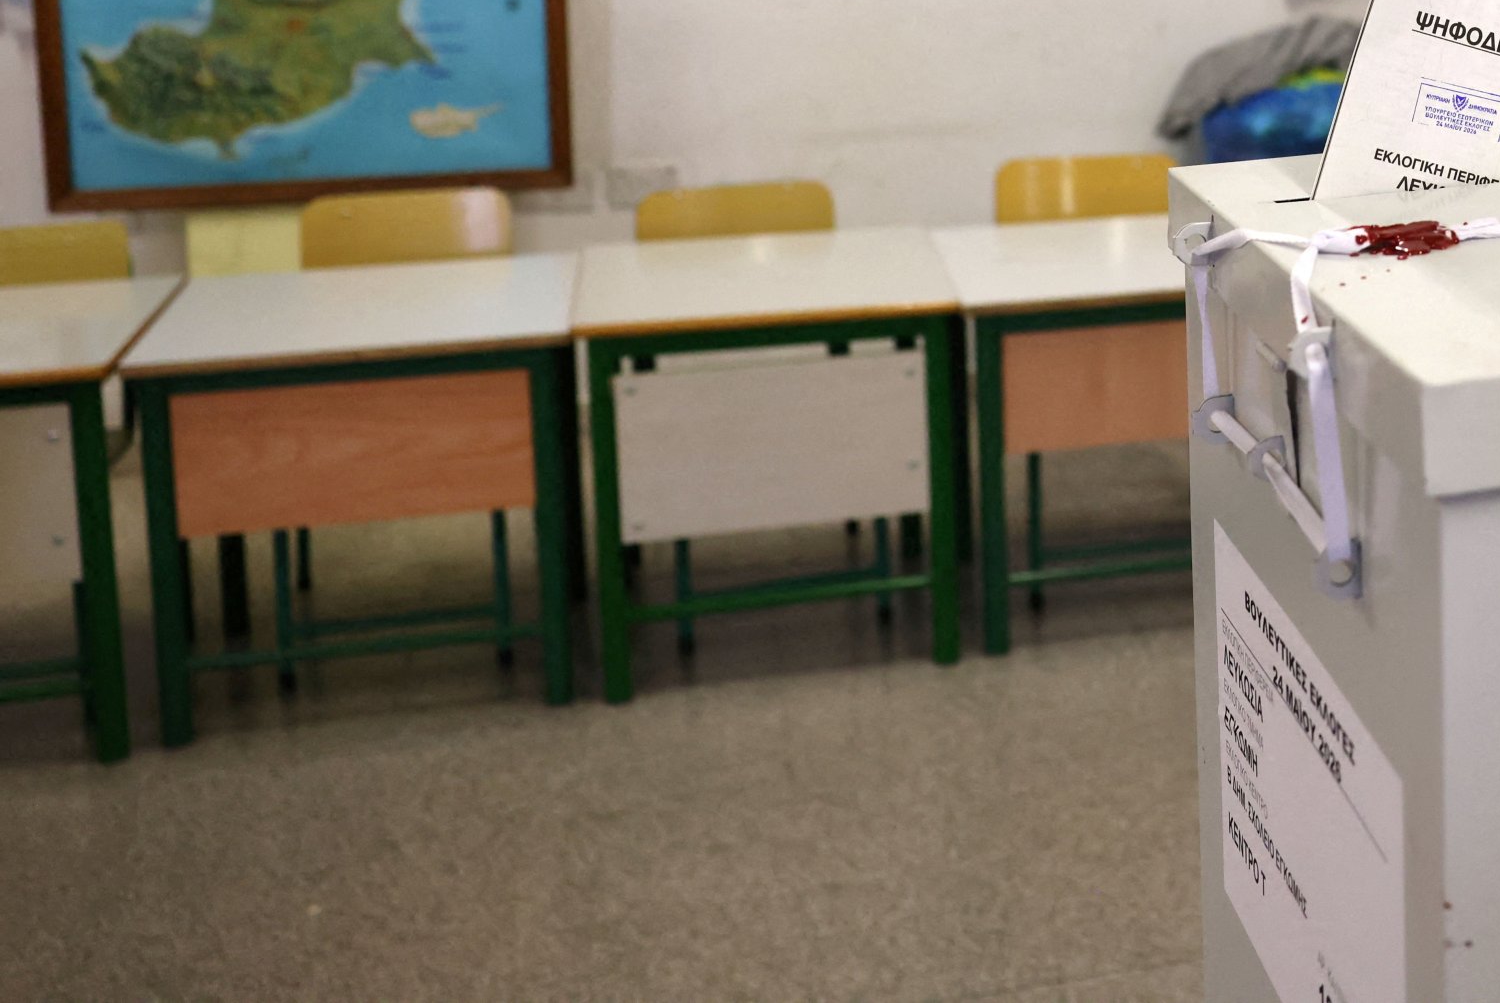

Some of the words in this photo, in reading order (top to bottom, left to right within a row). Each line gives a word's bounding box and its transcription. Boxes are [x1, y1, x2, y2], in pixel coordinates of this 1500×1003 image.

[1425, 106, 1457, 117] ΥΠΟΥΡΓΕΙΟ
[1457, 113, 1494, 126] ΕΣΩΤΕΡΙΚΩΝ
[1425, 112, 1463, 126] ΒΟΥΛΕΥΤΙΚΕΣ
[1464, 122, 1491, 132] ΕΚΛΟΓΕΣ
[1373, 148, 1445, 177] ΕΚΛΟΓΙΚΗ
[1224, 644, 1264, 723] ΛΕΥΚΩΣΙΑ
[1244, 590, 1308, 694] ΒΟΥΛΕΥΤΙΚΕΣ
[1309, 681, 1356, 767] ΕΚΛΟΓΕΣ
[1224, 705, 1258, 778] ΕΓΚΩΜΗ
[1272, 665, 1284, 695] 24
[1318, 734, 1342, 783] 2026
[1227, 764, 1232, 785] Β
[1232, 775, 1248, 812] ΔΗΜ.
[1248, 800, 1275, 859] ΣΧΟΛΕΙΟ
[1275, 848, 1308, 919] ΕΓΚΩΜΗΣ
[1228, 811, 1260, 884] ΚΕΝΤΡΟ
[1260, 870, 1266, 896] Τ
